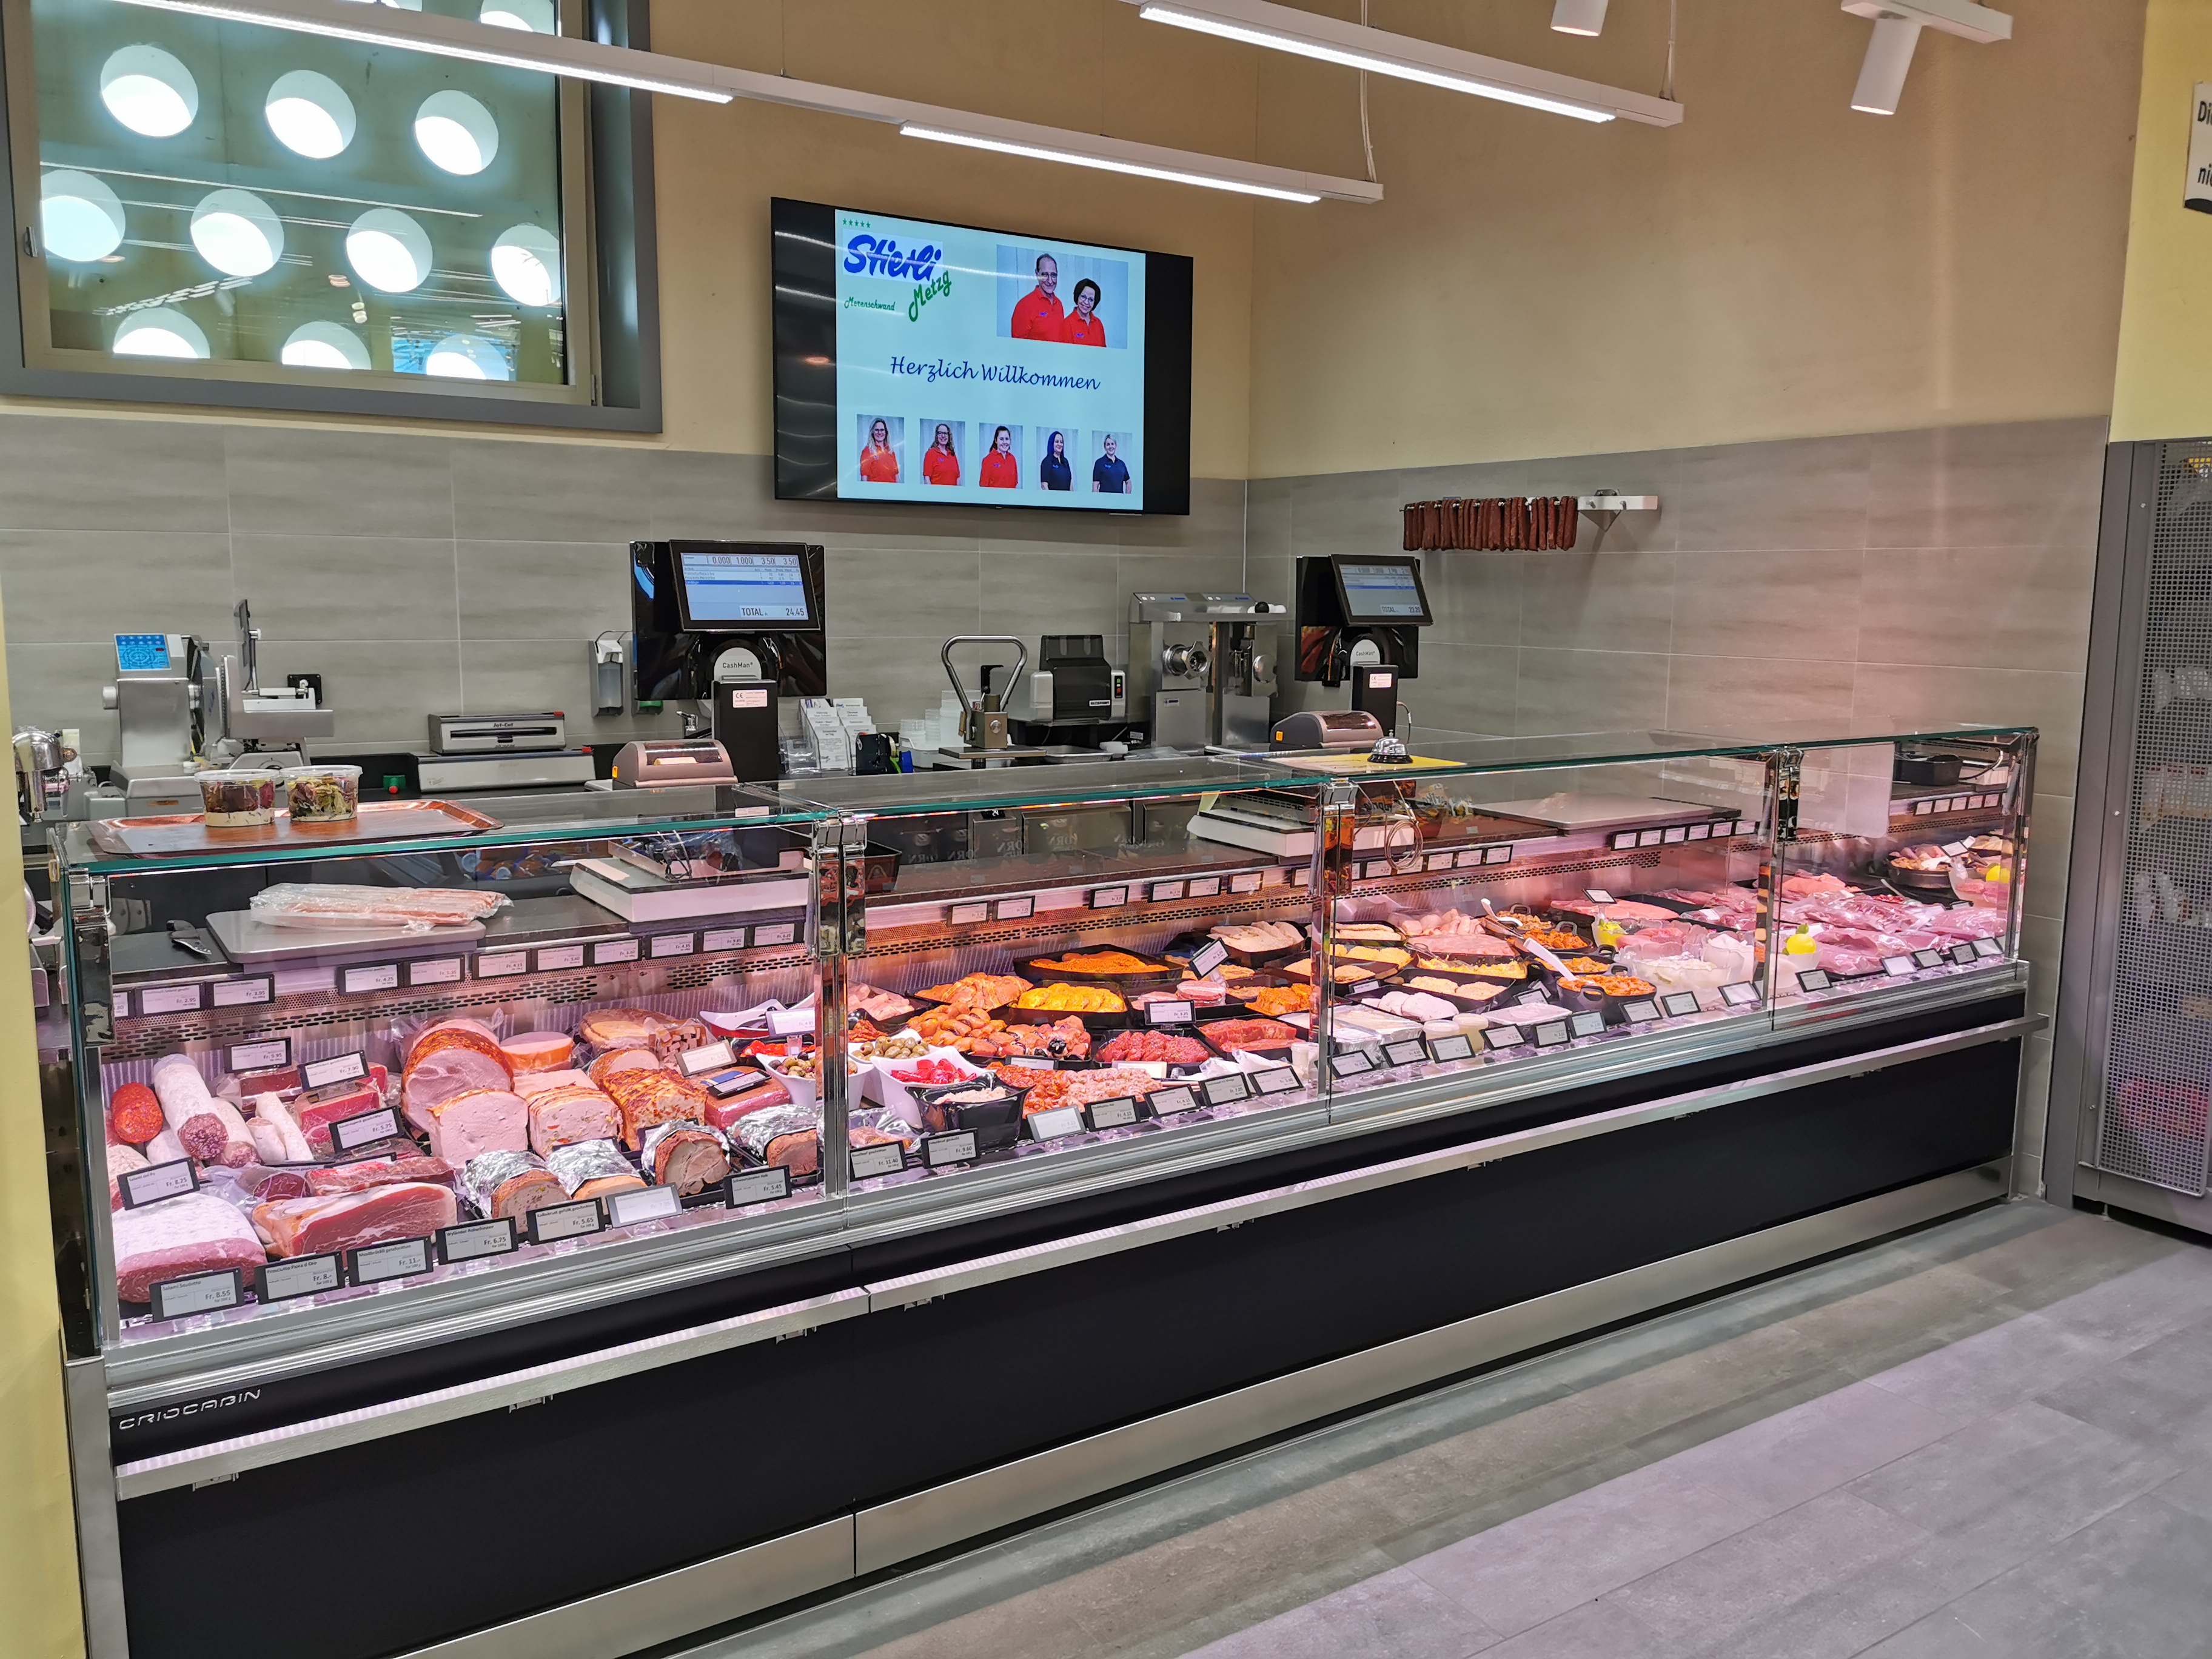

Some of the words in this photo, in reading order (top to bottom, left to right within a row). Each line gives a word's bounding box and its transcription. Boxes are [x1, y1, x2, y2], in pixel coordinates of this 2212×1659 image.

[2197, 100, 2212, 126] Di
[2197, 163, 2212, 187] ni
[843, 234, 942, 281] Stierli
[908, 270, 951, 322] Metzg
[890, 356, 979, 383] Herzlich
[981, 364, 1101, 390] Willkommen
[712, 556, 730, 565] 0.000
[742, 608, 763, 616] TOTAL
[119, 1389, 261, 1430] CRIOCABIN
